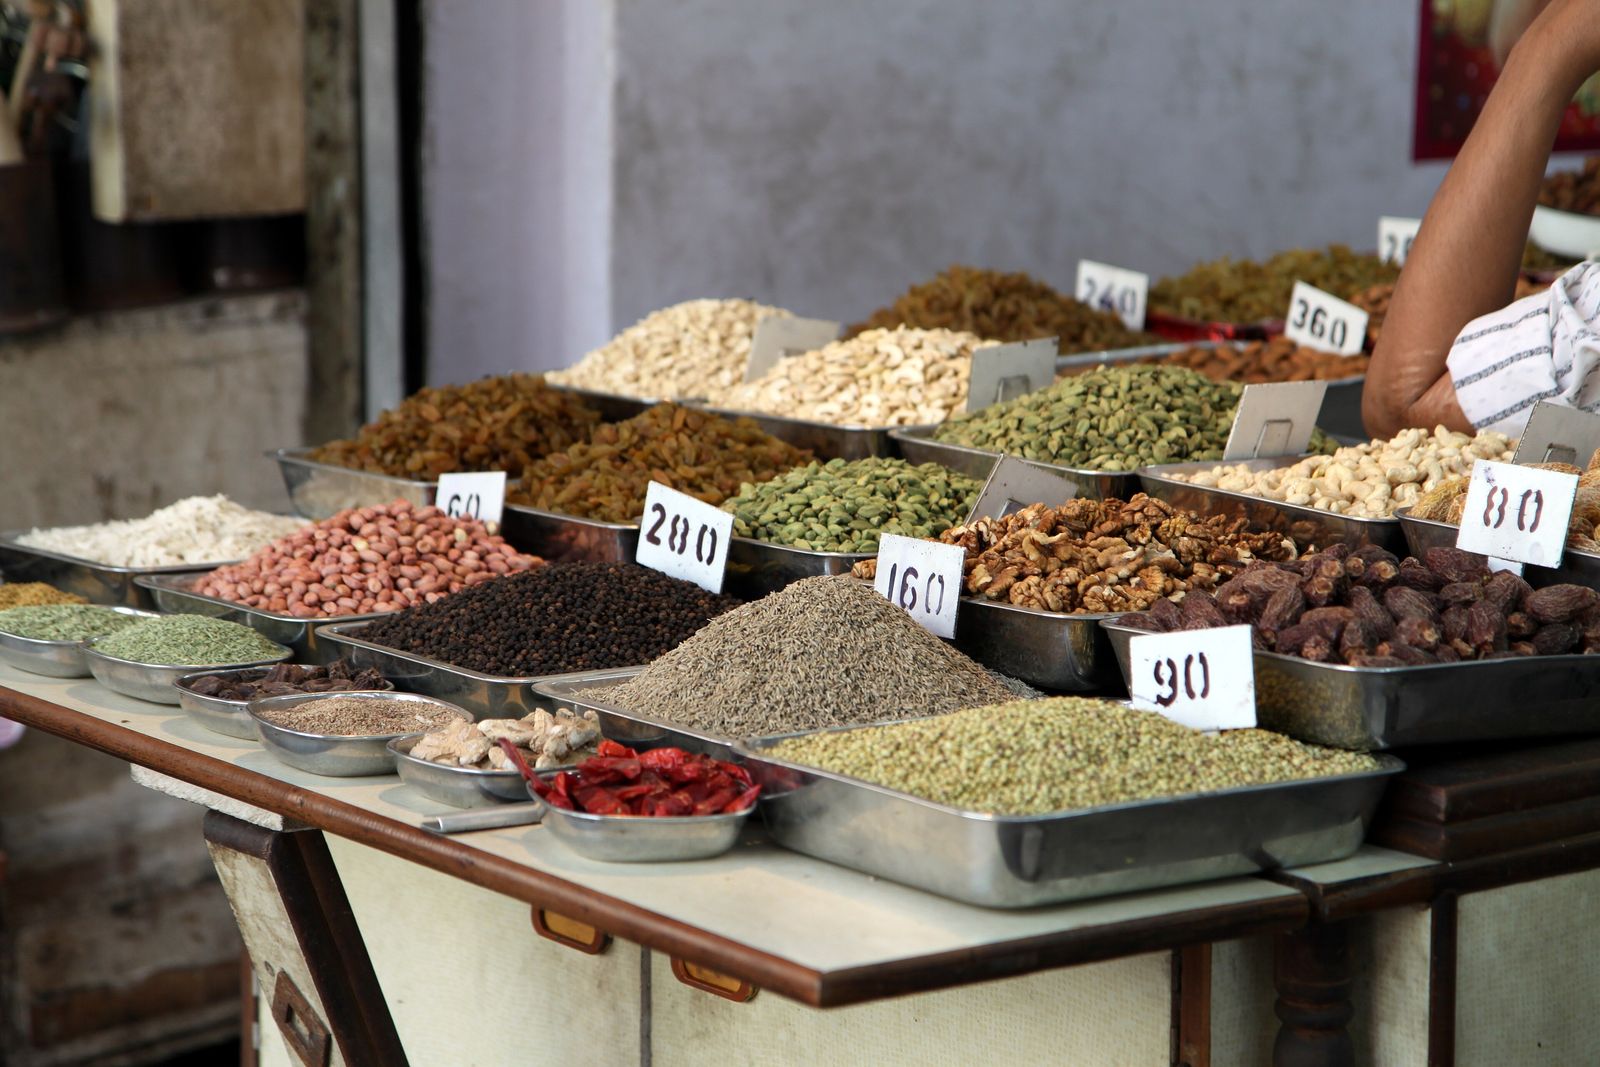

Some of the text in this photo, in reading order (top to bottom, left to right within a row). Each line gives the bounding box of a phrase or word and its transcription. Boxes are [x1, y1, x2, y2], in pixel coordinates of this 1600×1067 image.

[1292, 299, 1347, 348] 360
[448, 493, 480, 519] 60
[1483, 485, 1543, 533] 80
[646, 503, 717, 566] 280
[888, 563, 945, 615] 160
[1154, 652, 1211, 707] 90
